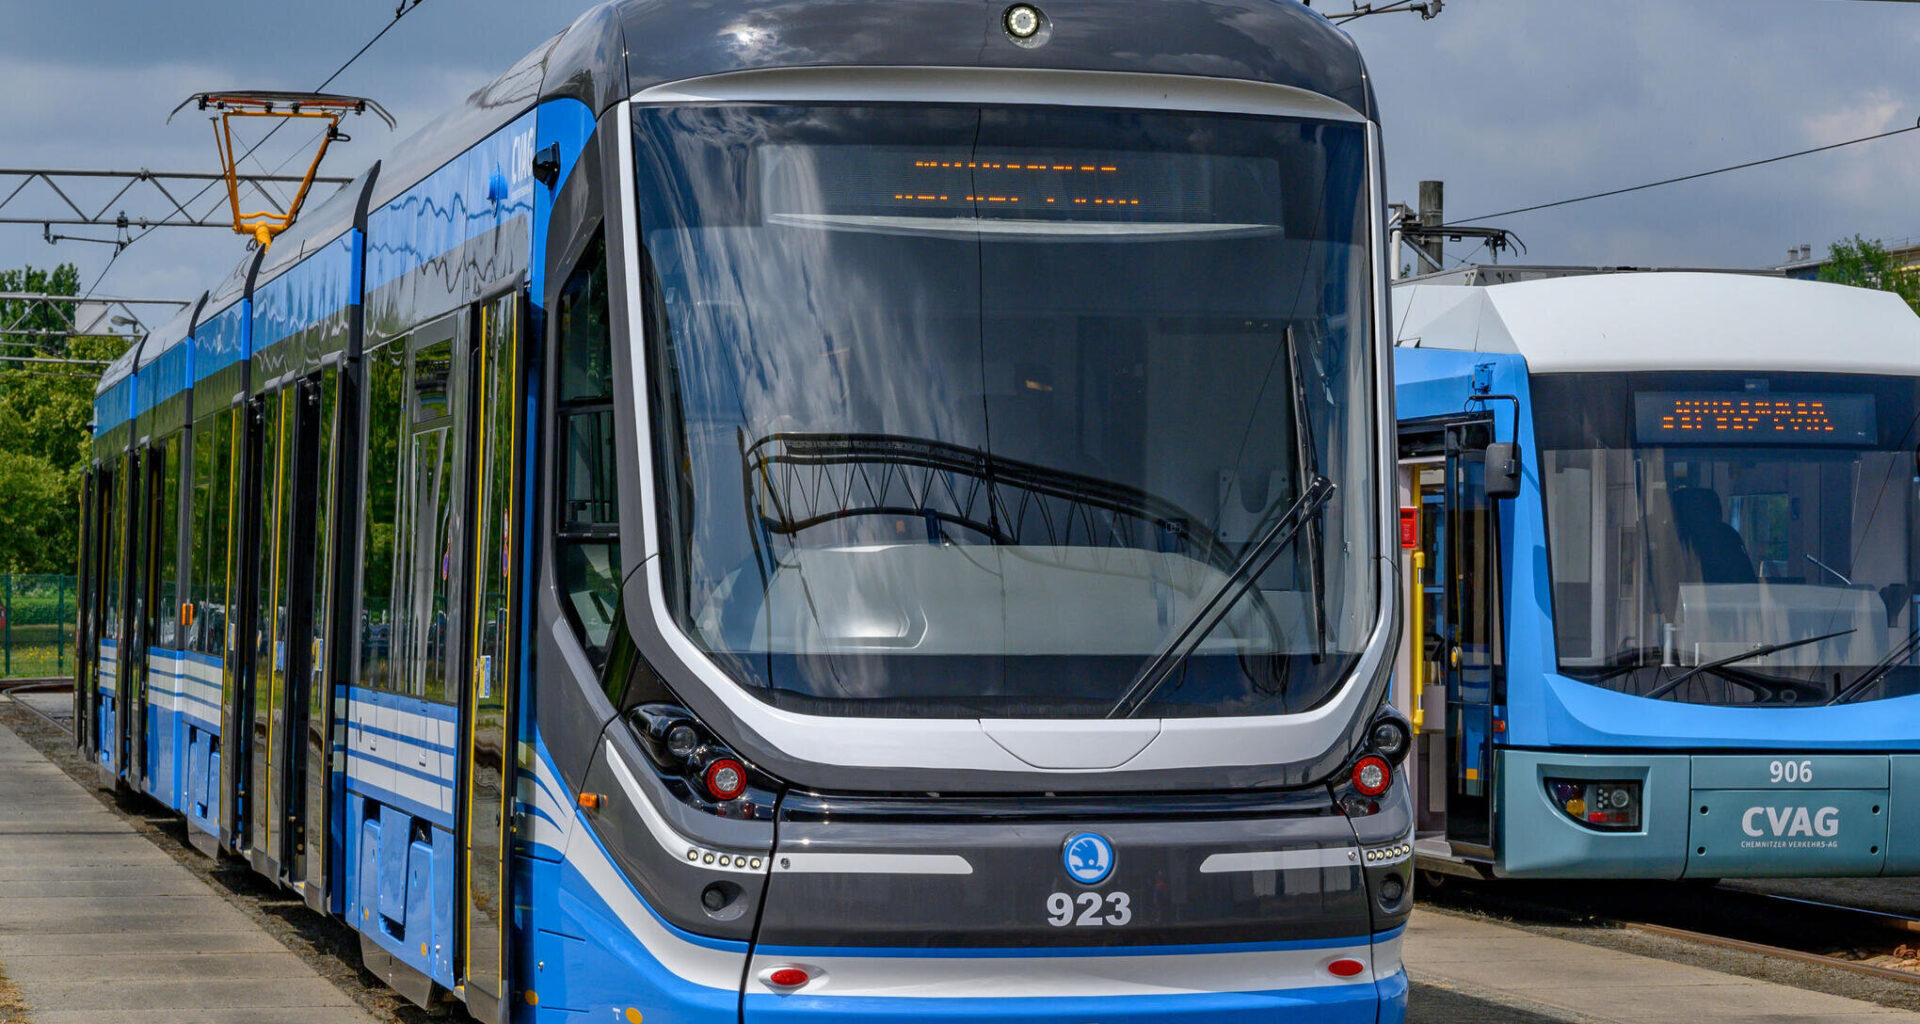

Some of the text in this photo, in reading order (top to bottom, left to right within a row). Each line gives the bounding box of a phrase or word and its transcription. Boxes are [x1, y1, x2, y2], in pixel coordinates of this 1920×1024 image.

[512, 127, 534, 185] CVAG
[1769, 760, 1813, 783] 906
[1741, 806, 1840, 837] CVAG
[1046, 891, 1132, 927] 923
